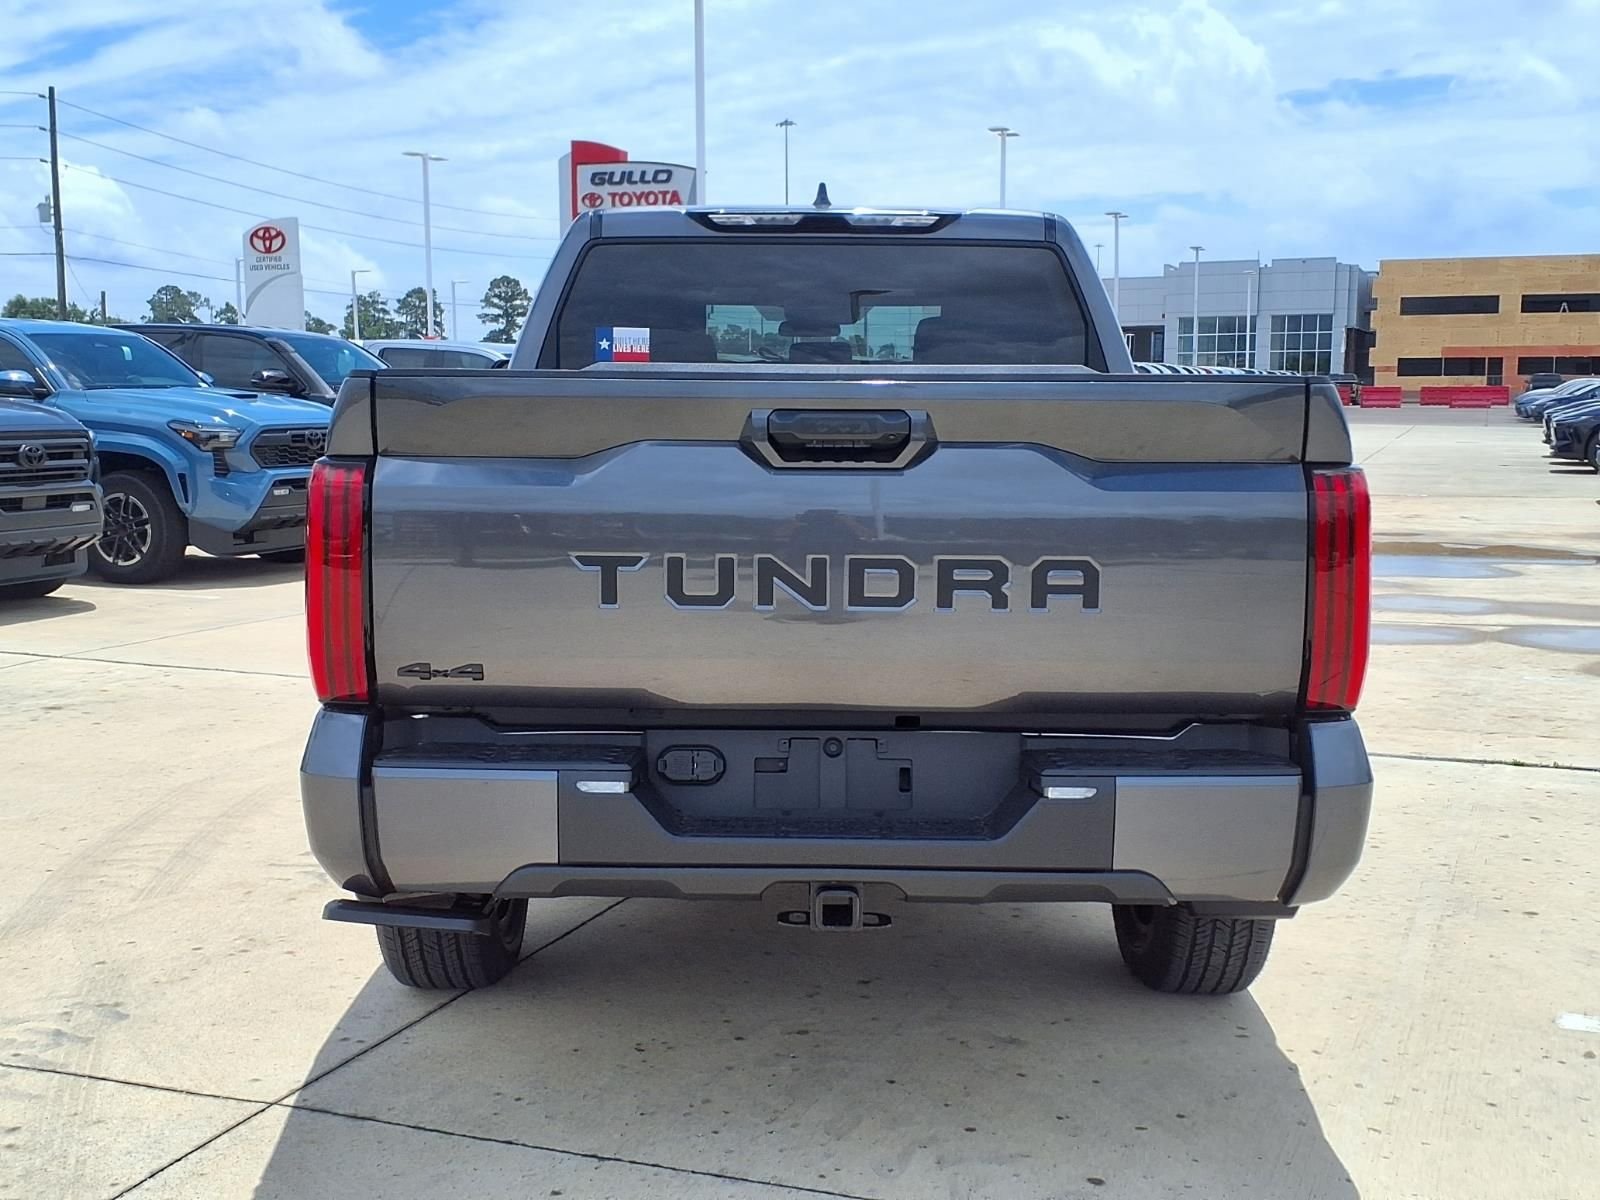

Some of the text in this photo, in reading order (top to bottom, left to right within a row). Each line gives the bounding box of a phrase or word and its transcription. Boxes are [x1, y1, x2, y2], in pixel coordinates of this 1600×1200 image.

[590, 169, 673, 186] GULLO
[607, 190, 683, 208] TOYOTA
[255, 255, 283, 263] CERTIFIED
[264, 263, 290, 271] VEHICLES
[568, 551, 1102, 614] TUNDRA
